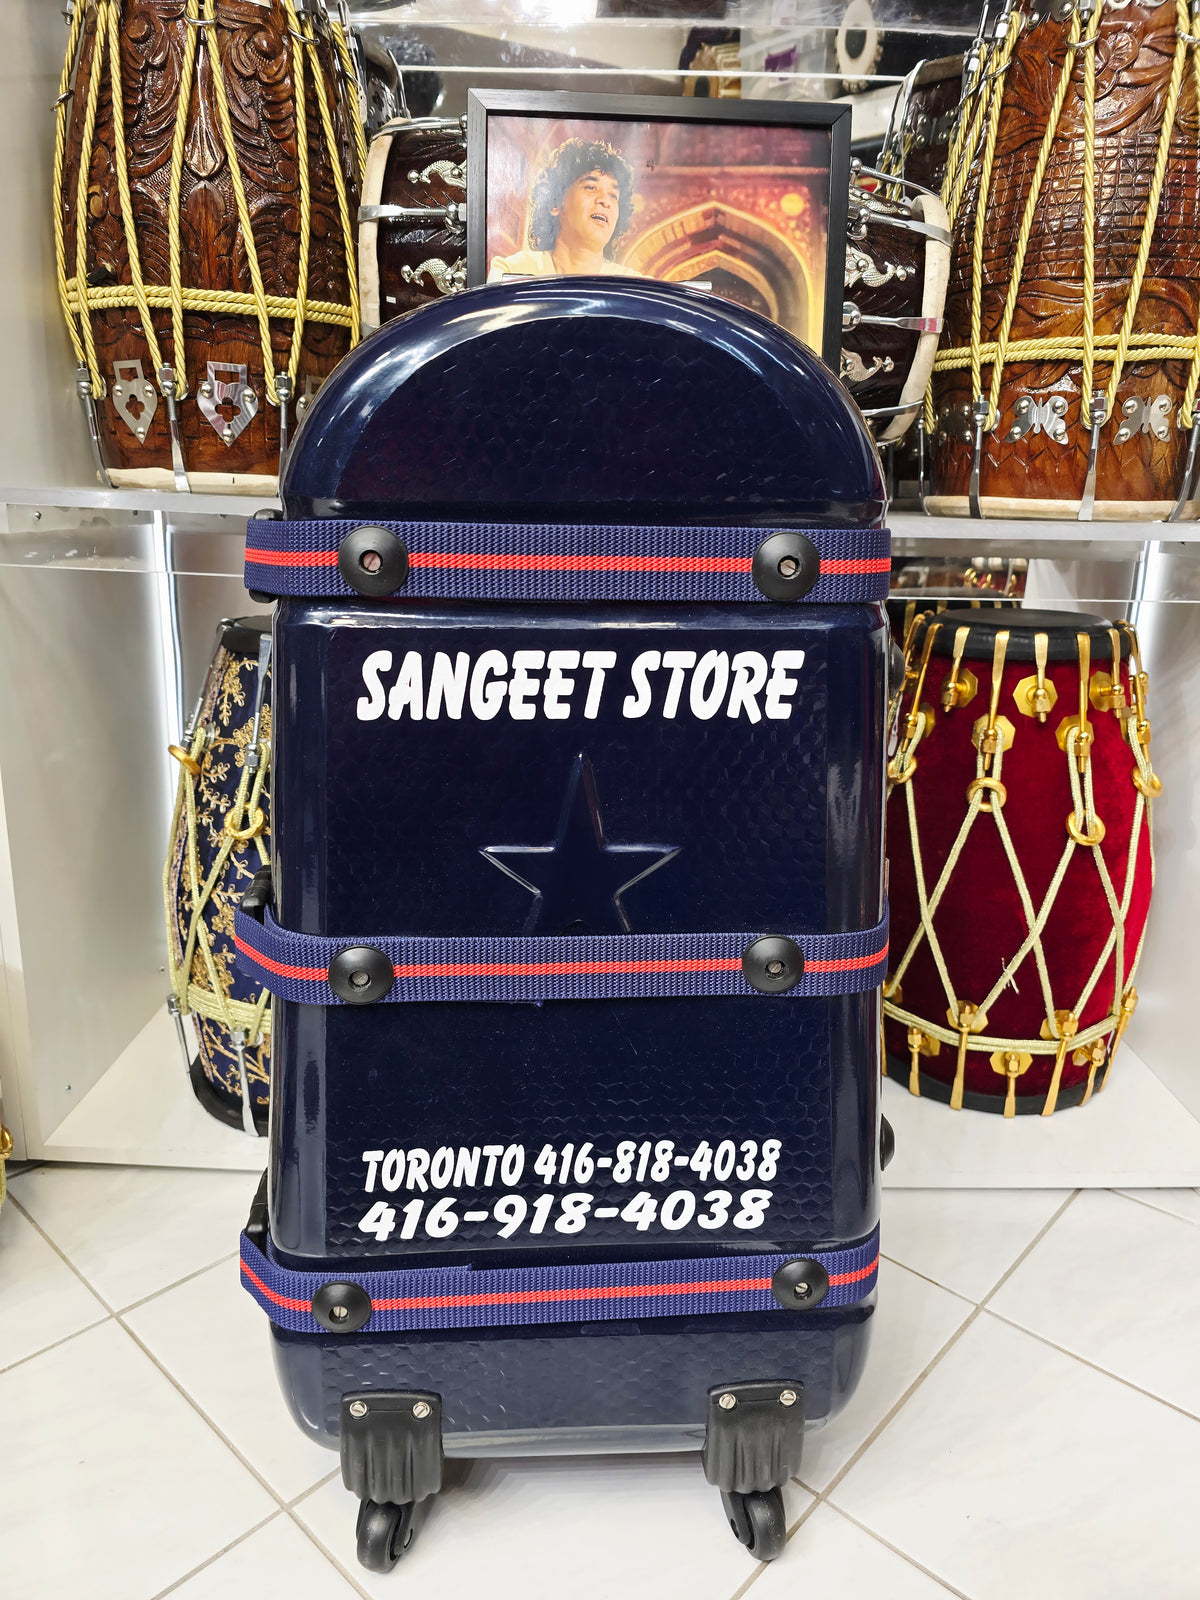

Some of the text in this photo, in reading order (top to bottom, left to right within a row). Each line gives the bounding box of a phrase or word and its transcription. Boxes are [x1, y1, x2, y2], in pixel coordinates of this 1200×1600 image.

[356, 649, 806, 725] SANGEET STORE
[361, 1138, 783, 1193] TORONTO 416-818-4038
[357, 1188, 774, 1241] 416-918-4038
